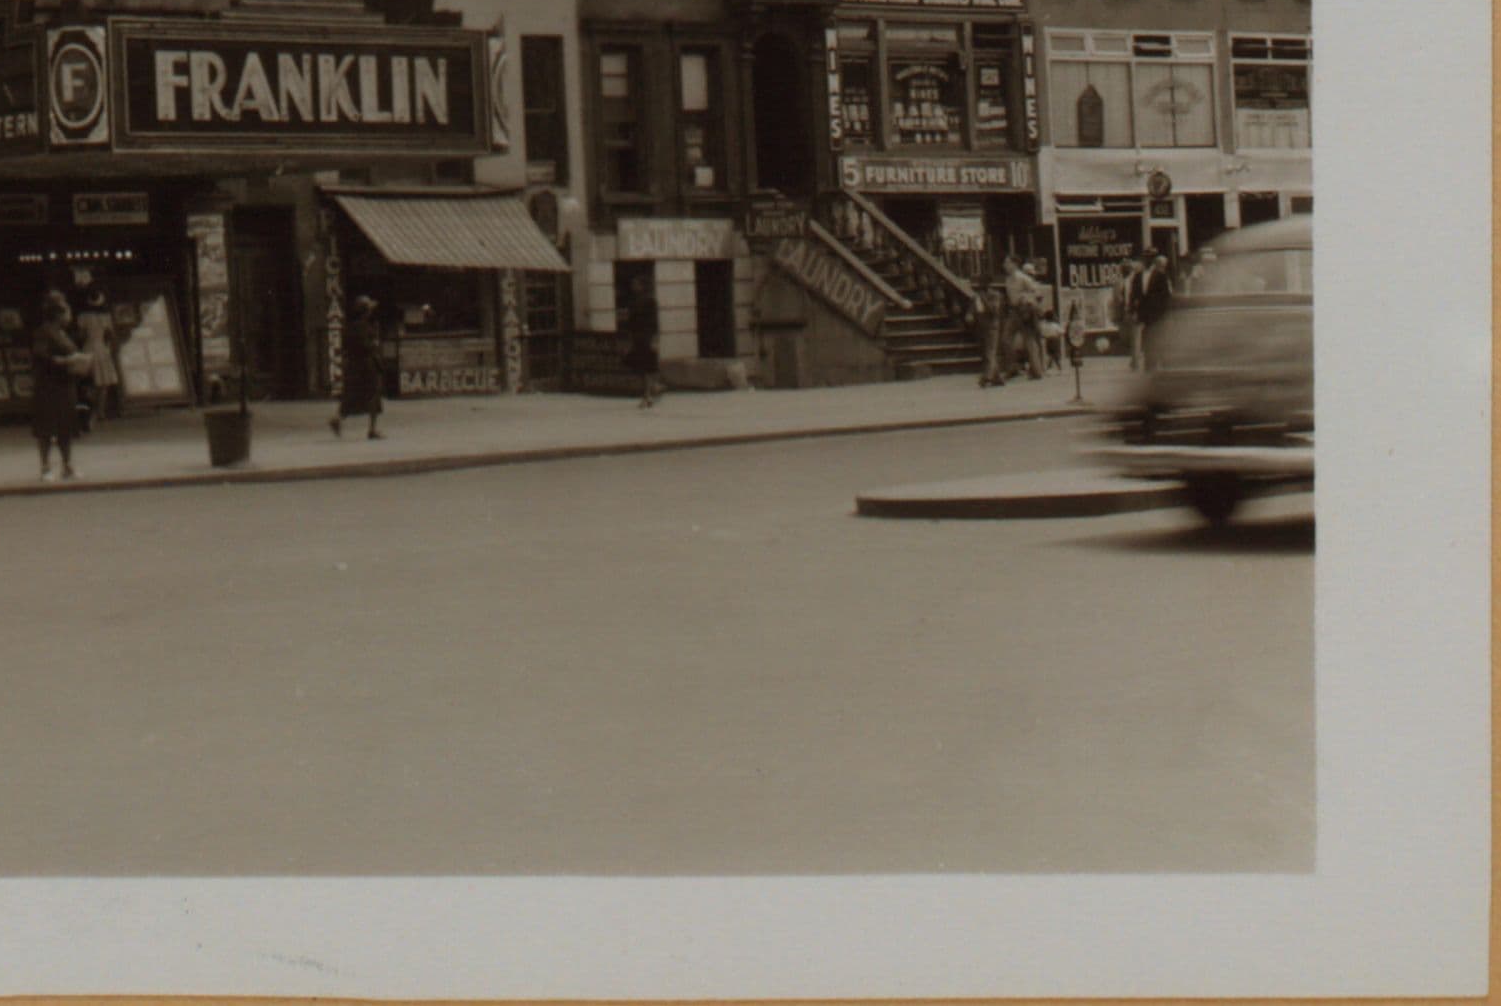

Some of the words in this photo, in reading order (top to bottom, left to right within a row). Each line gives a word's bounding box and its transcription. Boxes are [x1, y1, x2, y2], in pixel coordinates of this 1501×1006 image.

[61, 62, 90, 103] F
[153, 49, 450, 126] FRANKLIN
[1021, 34, 1039, 140] WINES
[865, 166, 956, 184] FURNITURE
[960, 167, 1005, 184] STORE
[745, 210, 805, 237] LAUNDRY
[628, 230, 725, 258] LAUNDRY
[775, 238, 885, 324] LAUNDRY
[399, 367, 501, 395] BARBECUE
